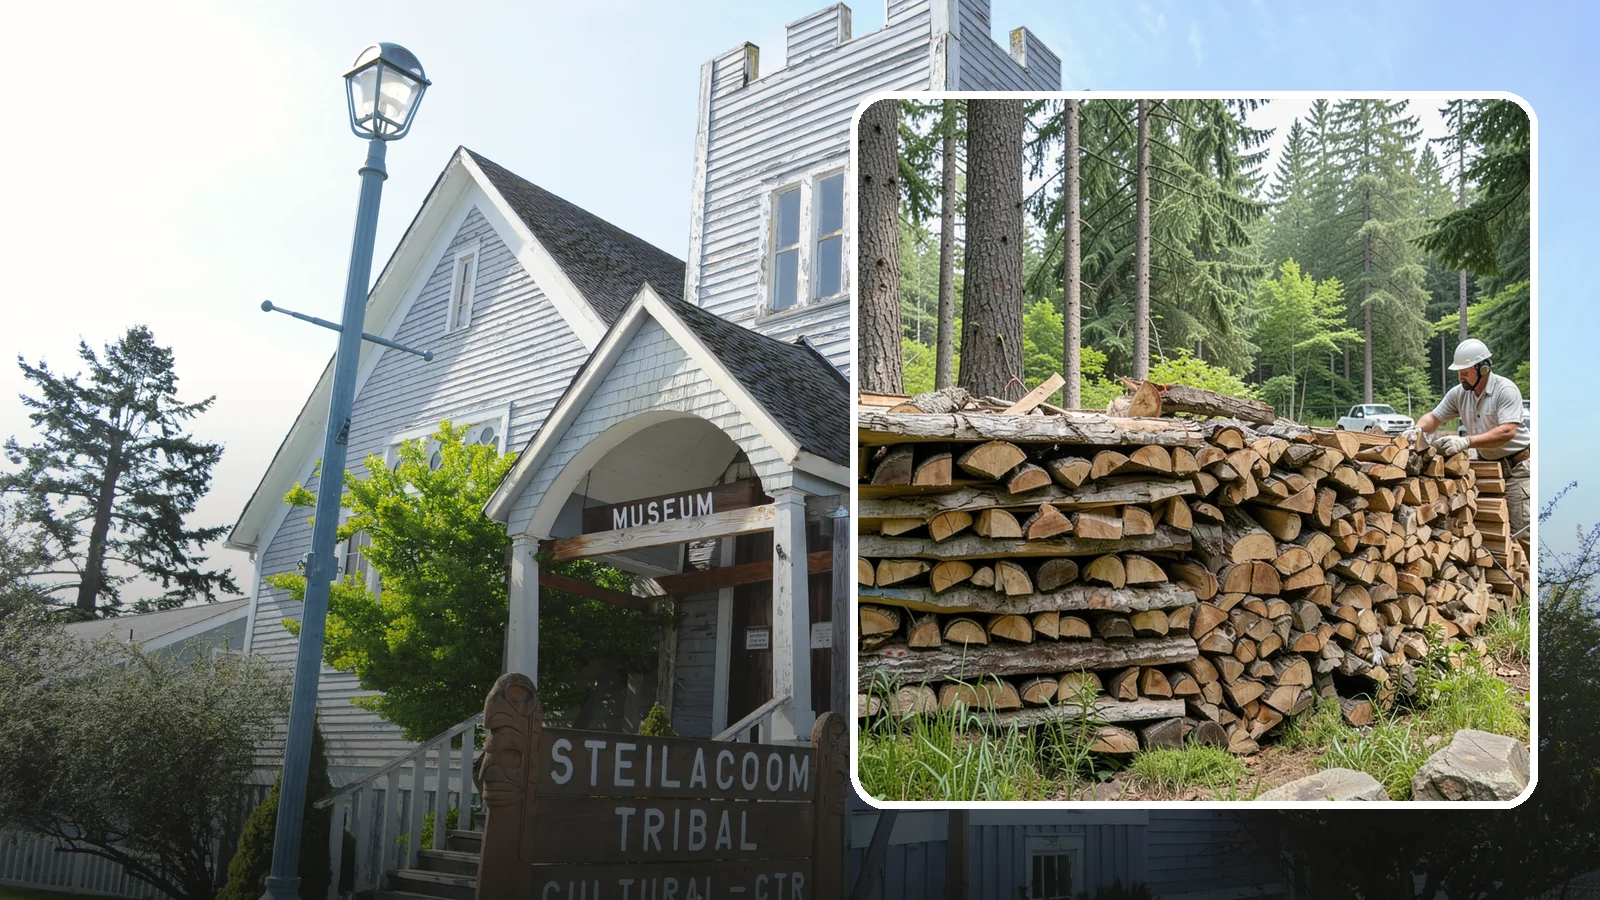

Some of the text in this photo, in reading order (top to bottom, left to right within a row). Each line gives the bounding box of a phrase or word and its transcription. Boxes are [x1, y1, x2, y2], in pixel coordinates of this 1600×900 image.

[612, 491, 714, 531] MUSEUM
[550, 738, 809, 793] STEILACOOM
[614, 806, 758, 852] TRIBAL
